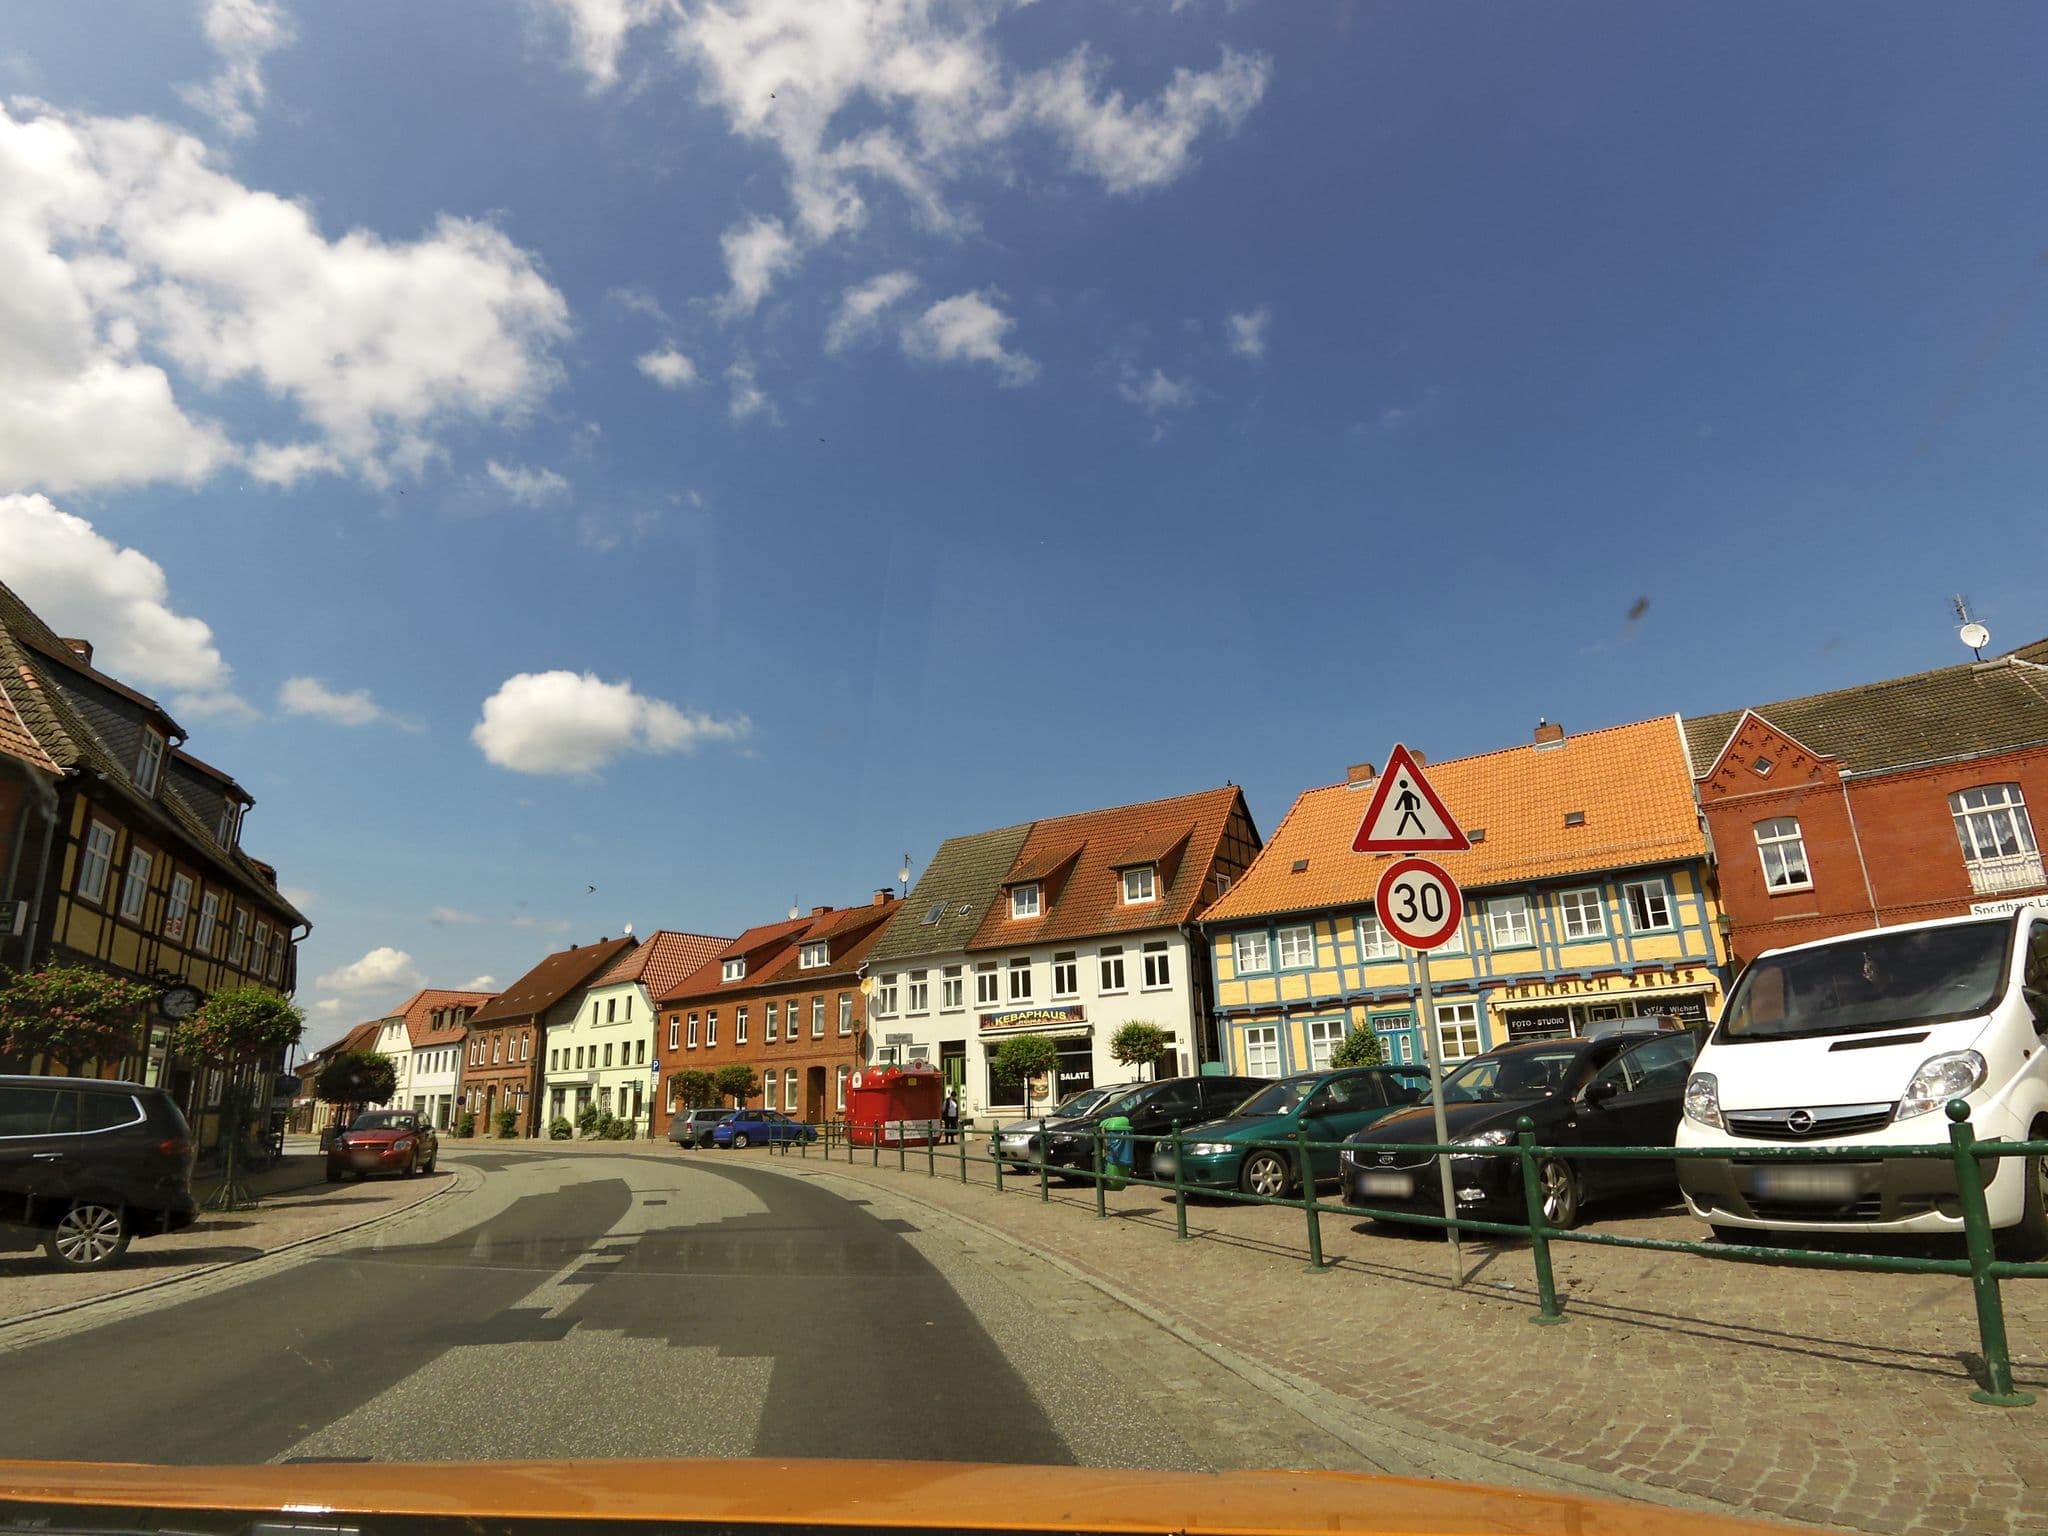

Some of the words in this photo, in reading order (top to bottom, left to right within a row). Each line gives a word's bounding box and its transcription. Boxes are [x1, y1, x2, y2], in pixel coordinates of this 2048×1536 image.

[1394, 883, 1444, 923] 30
[1505, 980, 1609, 999] HEINRICH
[1629, 970, 1695, 988] ZEISS
[1669, 1004, 1699, 1013] Wichert
[995, 1010, 1067, 1026] KEBAPHAUS
[1512, 1020, 1532, 1028] FOTO
[1537, 1017, 1565, 1026] STUDIO
[653, 1060, 659, 1071] P
[1060, 1071, 1090, 1081] SALATE
